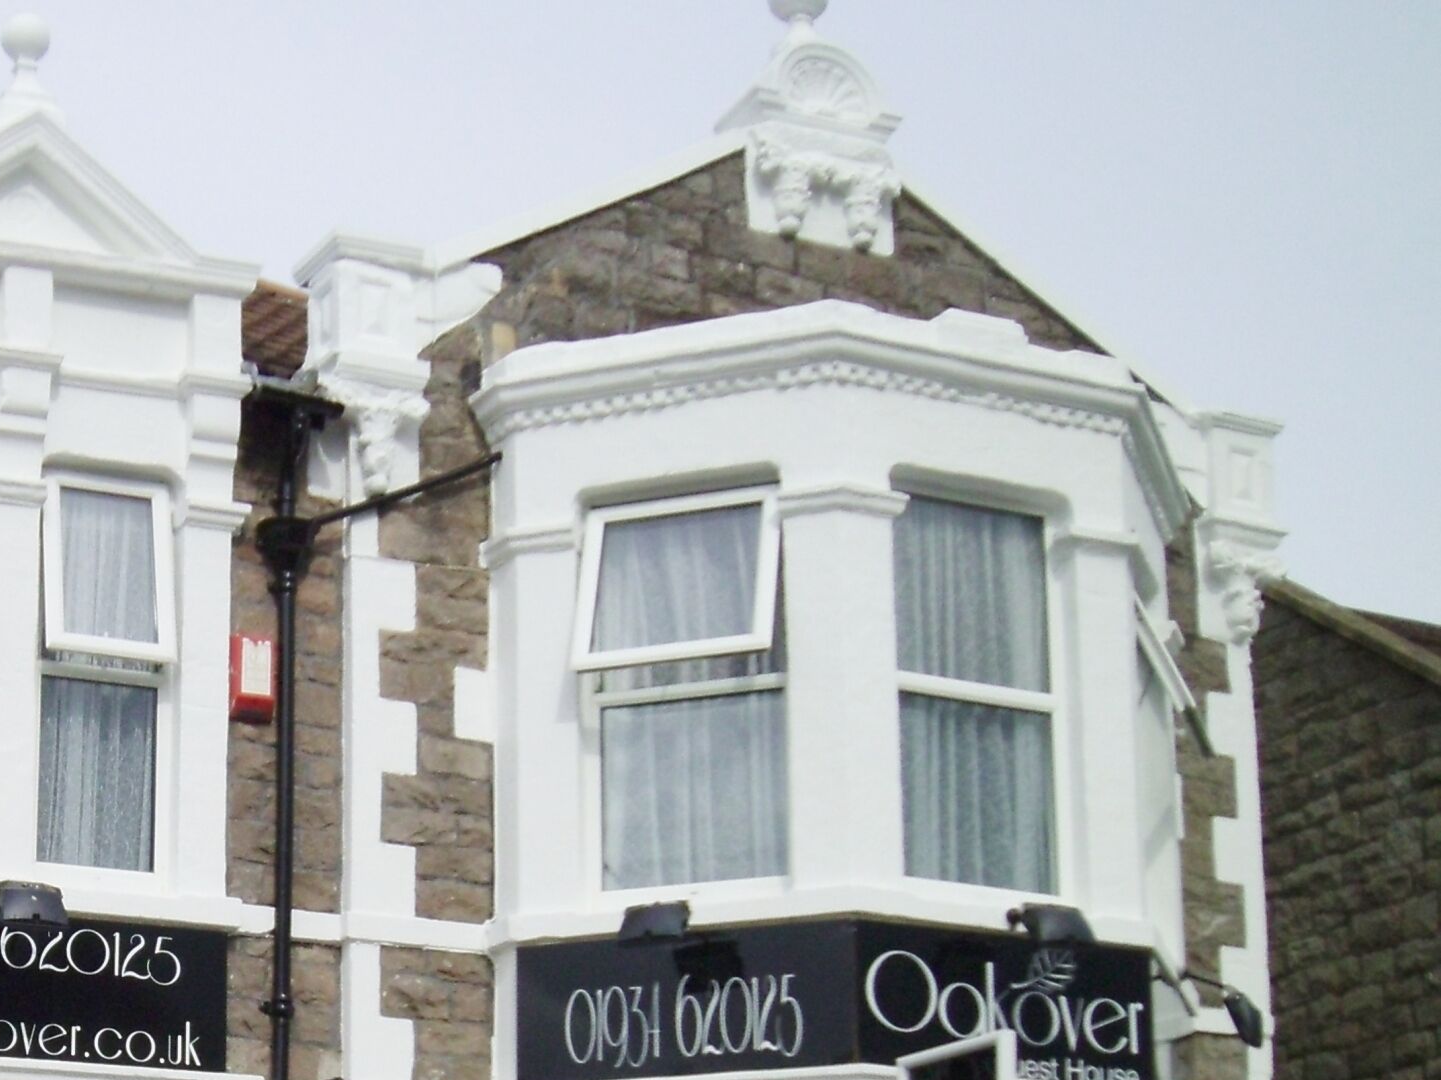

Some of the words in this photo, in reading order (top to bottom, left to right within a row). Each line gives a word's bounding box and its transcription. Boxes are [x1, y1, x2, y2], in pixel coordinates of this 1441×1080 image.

[0, 925, 182, 986] 620125
[674, 972, 804, 1058] 620125
[865, 949, 1144, 1057] Oakover
